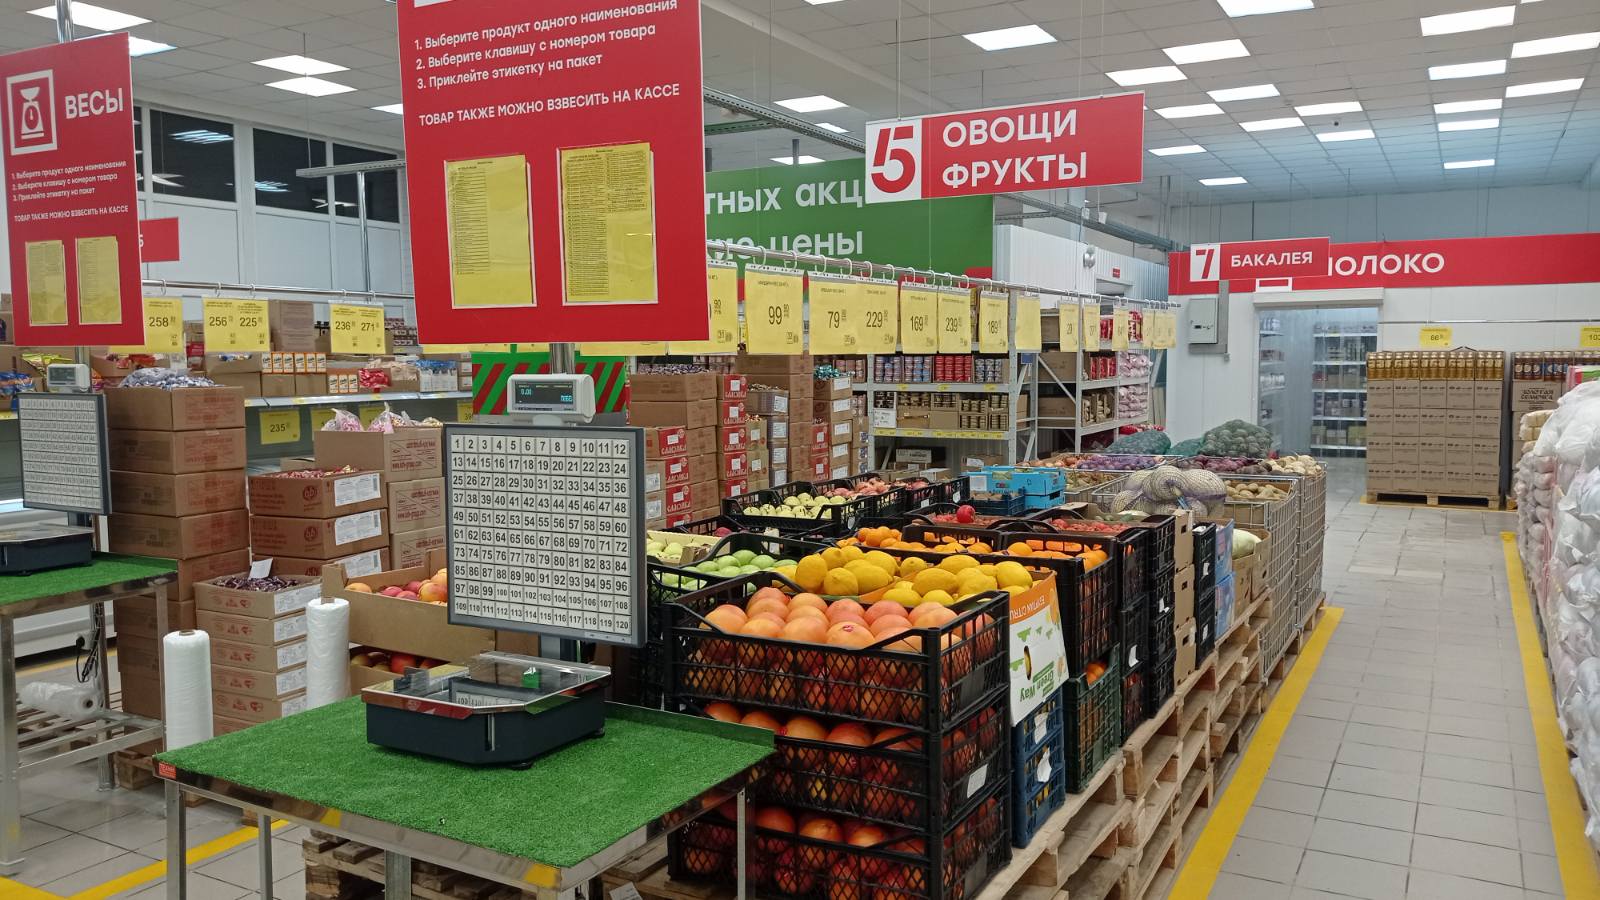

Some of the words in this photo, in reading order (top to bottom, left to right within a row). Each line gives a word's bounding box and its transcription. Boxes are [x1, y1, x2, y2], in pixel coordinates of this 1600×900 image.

[414, 40, 422, 50] 1.
[425, 31, 479, 48] Выберите
[482, 22, 530, 42] продукт
[534, 15, 577, 31] одного
[581, 0, 678, 24] наименования
[416, 58, 425, 70] 2.
[428, 51, 482, 67] Выберите
[485, 42, 536, 56] клавишу
[540, 41, 547, 51] с
[550, 32, 605, 49] номером
[609, 24, 656, 40] товара
[418, 78, 426, 90] 3.
[429, 69, 489, 90] Приклейте
[492, 62, 544, 76] этикетку
[548, 60, 563, 71] на
[566, 54, 602, 68] пакет
[65, 87, 124, 119] ВЕСЫ
[418, 112, 454, 126] ТОВАР
[457, 106, 495, 122] ТАКЖЕ
[498, 100, 544, 117] МОЖНО
[547, 92, 609, 110] ВЗВЕСИТЬ
[613, 89, 631, 103] НА
[635, 83, 680, 100] КАССЕ
[942, 109, 1077, 148] ОВОЩИ
[870, 125, 917, 194] 5
[942, 151, 1087, 189] ФРУКТЫ
[1196, 248, 1214, 280] 7
[1231, 251, 1313, 268] БАКАЛЕЯ
[1328, 252, 1445, 276] ОЛОКО
[149, 316, 169, 327] 258
[209, 316, 227, 327] 256
[239, 316, 257, 327] 225
[768, 306, 782, 325] 99
[828, 311, 840, 328] 79
[866, 312, 883, 328] 229
[910, 316, 923, 332] 169
[945, 318, 958, 332] 239
[335, 321, 350, 330] 236
[361, 322, 374, 332] 271
[270, 424, 285, 432] 235
[453, 438, 460, 449] 1
[466, 439, 474, 449] 2
[480, 439, 488, 450] 3
[495, 440, 503, 451] 4
[509, 440, 517, 451] 5
[523, 440, 532, 452] 6
[538, 441, 547, 452] 7
[553, 441, 561, 453] 8
[568, 442, 576, 453] 9
[582, 442, 595, 453] 10
[598, 442, 609, 454] 11
[614, 443, 627, 455] 12
[452, 456, 464, 467] 13
[466, 457, 477, 467] 14
[480, 457, 492, 468] 15
[494, 458, 505, 469] 16
[508, 459, 520, 470] 17
[522, 459, 535, 470] 18
[537, 460, 549, 471] 19
[552, 460, 564, 472] 20
[567, 461, 579, 472] 21
[582, 461, 595, 473] 22
[598, 462, 611, 474] 23
[613, 463, 627, 475] 24
[452, 475, 464, 486] 25
[466, 475, 478, 486] 26
[480, 476, 492, 487] 27
[494, 476, 506, 488] 28
[508, 477, 520, 488] 29
[522, 478, 535, 489] 30
[537, 478, 548, 490] 31
[552, 479, 565, 491] 32
[567, 480, 580, 492] 33
[582, 481, 596, 492] 34
[598, 481, 611, 493] 35
[614, 482, 627, 494] 36
[453, 492, 465, 504] 37
[466, 493, 478, 504] 38
[480, 494, 492, 505] 39
[494, 495, 506, 506] 40
[508, 496, 520, 507] 41
[522, 496, 535, 508] 42
[537, 497, 550, 509] 43
[552, 498, 565, 510] 44
[567, 499, 580, 511] 45
[582, 500, 596, 512] 46
[598, 501, 611, 512] 47
[614, 502, 627, 514] 48
[453, 511, 464, 521] 49
[467, 512, 479, 523] 50
[481, 512, 492, 524] 51
[495, 513, 507, 525] 52
[509, 514, 521, 526] 53
[524, 516, 536, 527] 54
[538, 516, 550, 528] 55
[553, 517, 565, 529] 56
[568, 519, 580, 530] 57
[583, 519, 596, 531] 58
[598, 520, 612, 532] 59
[614, 522, 627, 534] 60
[453, 528, 464, 540] 61
[467, 529, 479, 541] 62
[481, 530, 493, 542] 63
[495, 532, 507, 543] 64
[509, 533, 521, 544] 65
[523, 534, 536, 546] 66
[538, 535, 551, 547] 67
[553, 536, 566, 548] 68
[568, 537, 581, 549] 69
[583, 538, 596, 550] 70
[599, 540, 611, 552] 71
[615, 541, 628, 553] 72
[1036, 671, 1054, 690] Green
[1020, 686, 1036, 702] Way
